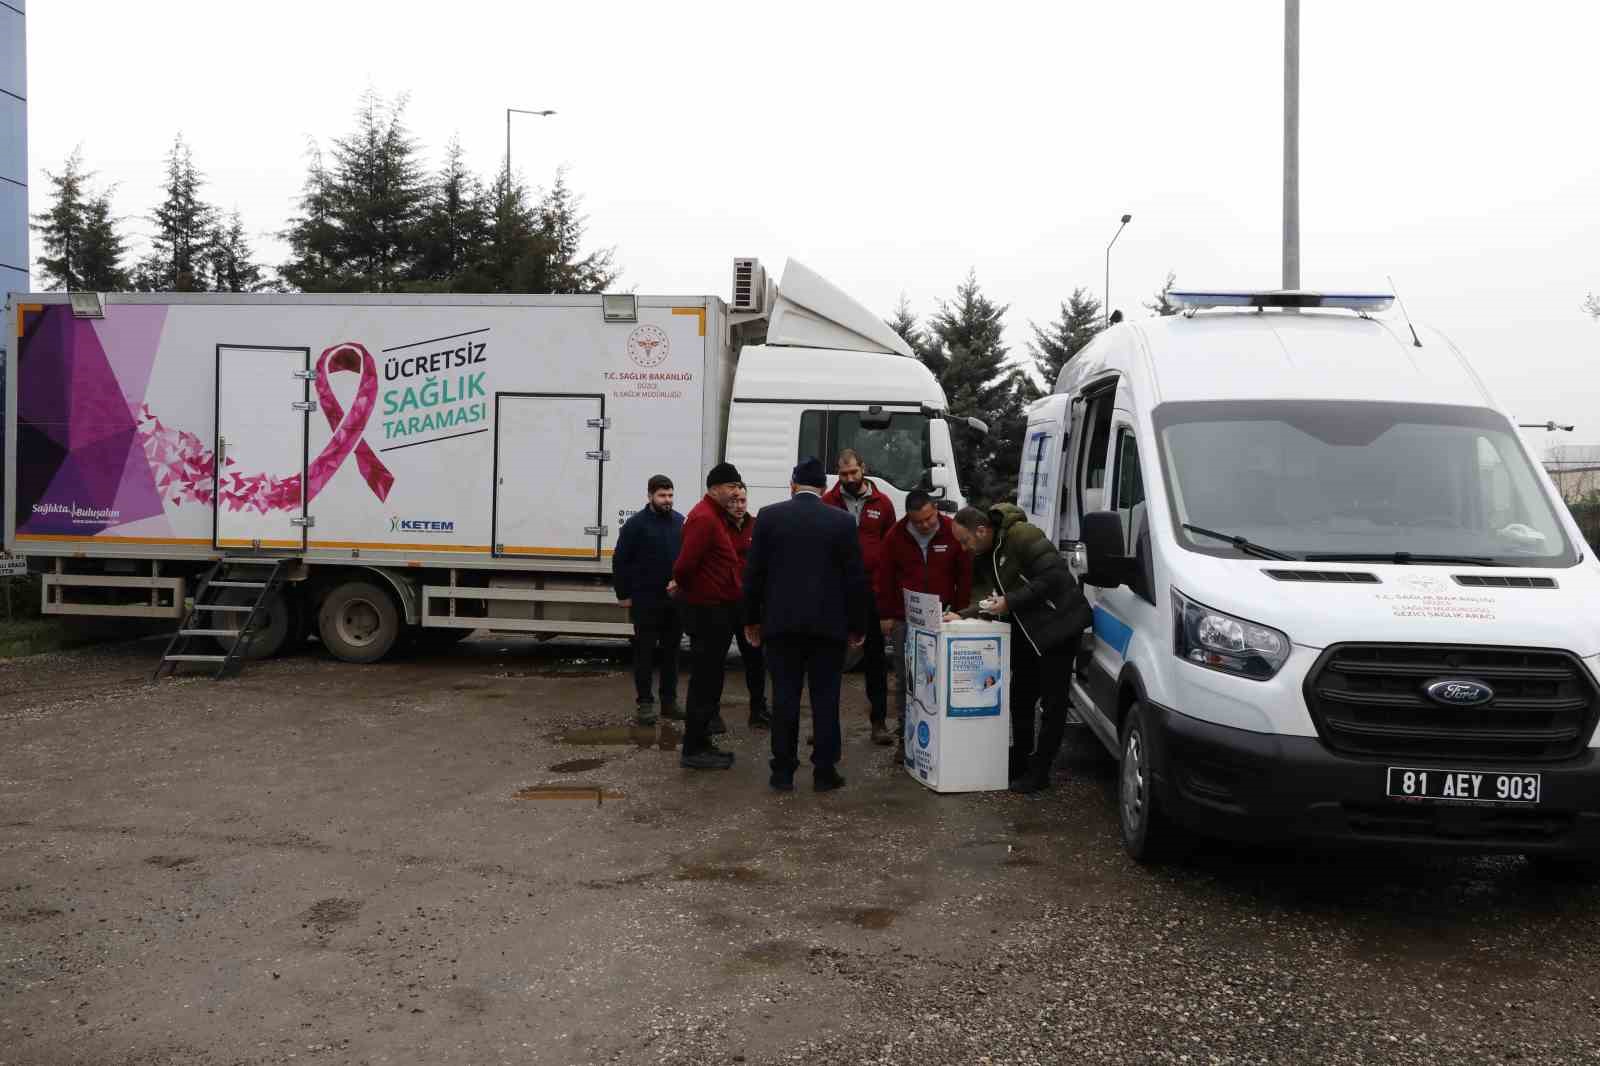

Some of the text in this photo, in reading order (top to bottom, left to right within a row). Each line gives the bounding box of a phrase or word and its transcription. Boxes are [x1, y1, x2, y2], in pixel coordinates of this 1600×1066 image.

[384, 341, 487, 381] ÜCRETSİZ
[383, 371, 486, 415] SAĞLIK
[382, 402, 486, 439] TARAMASI
[401, 520, 454, 530] KETEM
[1443, 684, 1480, 699] Ford
[1402, 772, 1537, 799] 81 AEY 903
